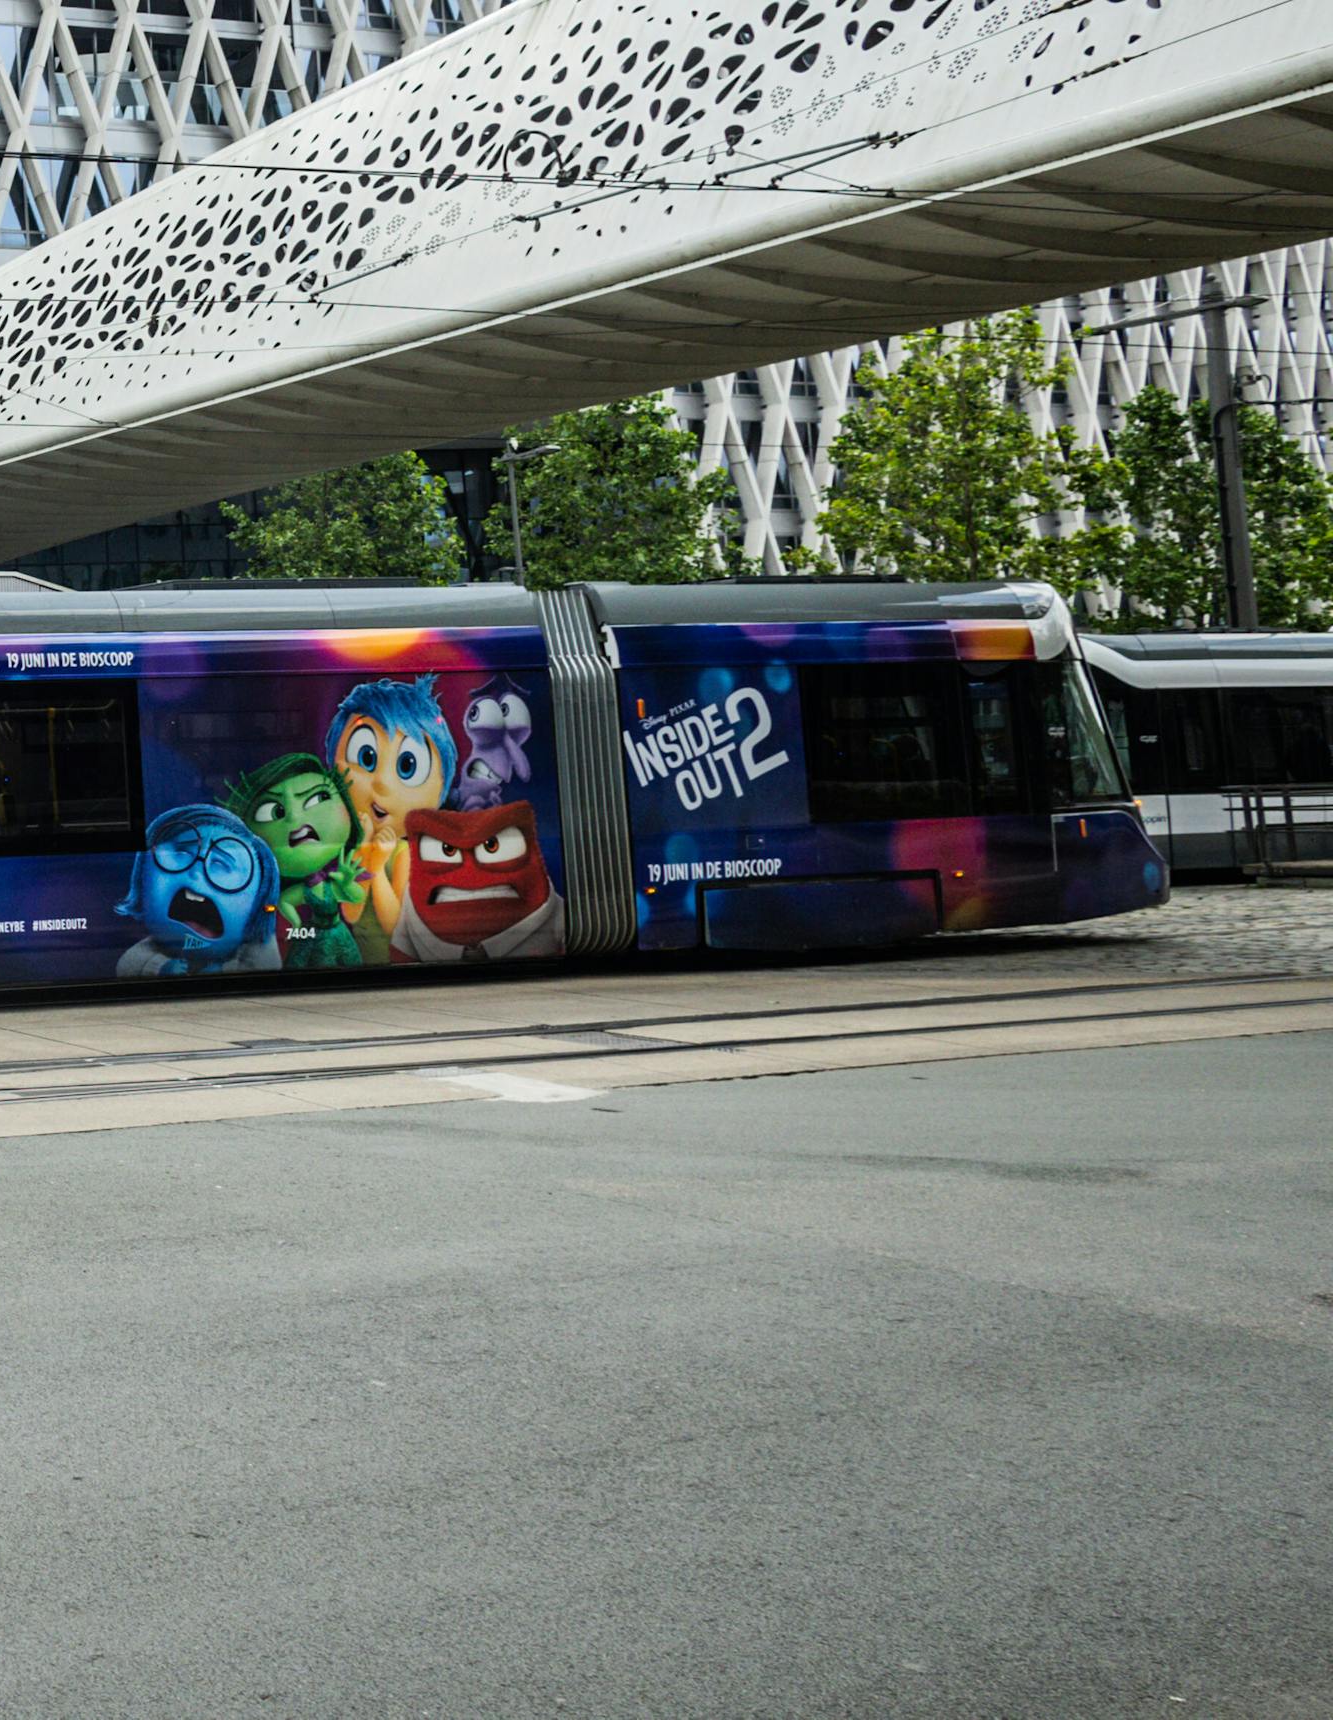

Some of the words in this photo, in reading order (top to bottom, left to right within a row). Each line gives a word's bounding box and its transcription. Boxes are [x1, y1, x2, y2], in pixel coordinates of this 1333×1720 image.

[6, 653, 19, 668] 19
[20, 653, 45, 671] JUNI
[47, 653, 60, 668] IN
[62, 652, 77, 668] DE
[79, 651, 134, 667] BIOSCOOP
[668, 699, 697, 718] PIXAR
[623, 703, 735, 787] INSIDE
[675, 742, 744, 811] OUT
[725, 687, 790, 781] 2
[647, 864, 661, 882] 19
[662, 863, 689, 885] JUNI
[691, 862, 704, 880] IN
[706, 861, 722, 879] DE
[724, 858, 782, 878] BIOSCOOP
[32, 918, 88, 931] #INSIDEOUT2
[285, 927, 316, 940] 7404
